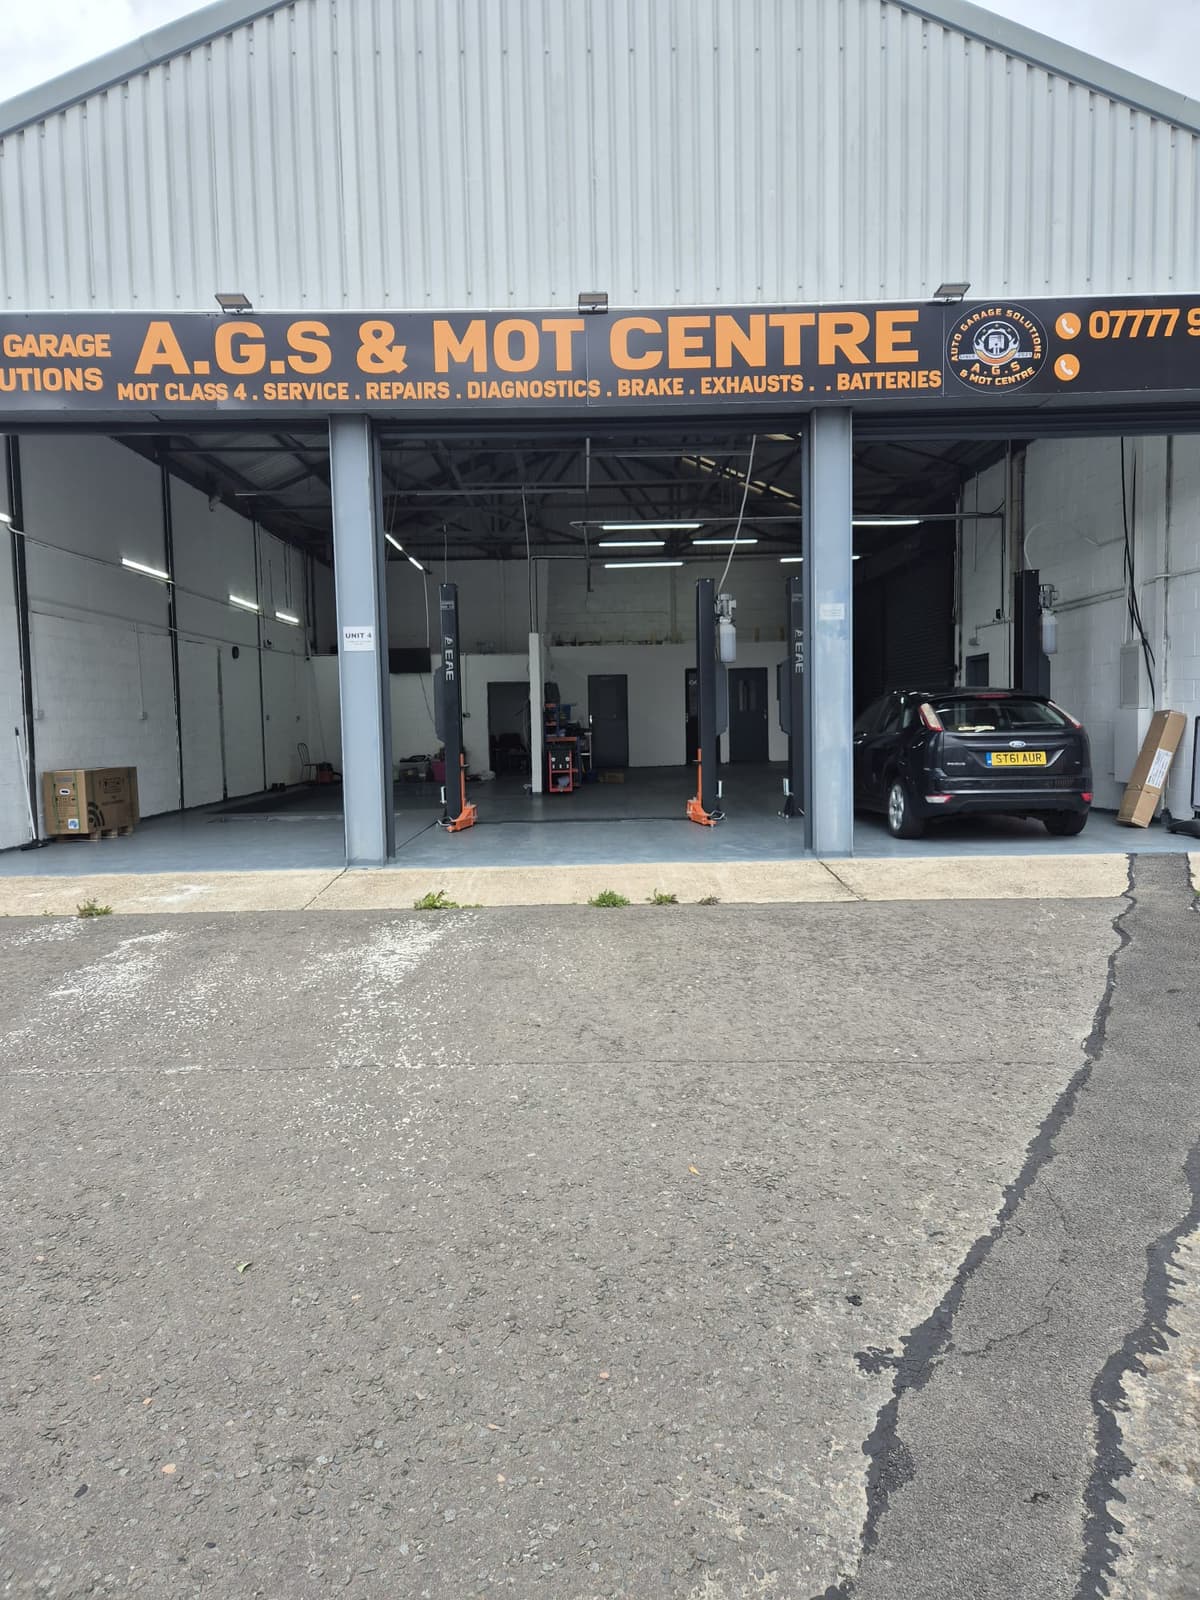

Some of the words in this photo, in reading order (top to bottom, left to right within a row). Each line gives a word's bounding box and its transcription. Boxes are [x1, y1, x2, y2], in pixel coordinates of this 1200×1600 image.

[951, 334, 961, 361] AUTO
[960, 308, 1002, 331] GARAGE
[1006, 310, 1041, 359] SOLUTIONS
[1089, 308, 1181, 340] 07777
[3, 334, 112, 358] GARAGE
[135, 321, 332, 376] A.G.S
[357, 320, 408, 374] &
[433, 319, 586, 373] MOT
[609, 309, 919, 371] CENTRE
[117, 383, 160, 401] MOT
[164, 383, 229, 401] CLASS
[234, 383, 247, 401] 4
[263, 382, 349, 401] SERVICE
[365, 382, 450, 400] REPAIRS
[466, 379, 602, 399] DIAGNOSTICS
[617, 377, 684, 397] BRAKE
[700, 374, 804, 395] EXHAUSTS
[836, 370, 943, 391] BATTERIES
[969, 375, 992, 385] MOT
[995, 367, 1035, 385] CENTRE
[995, 753, 1020, 764] ST61
[1022, 753, 1042, 763] AUR
